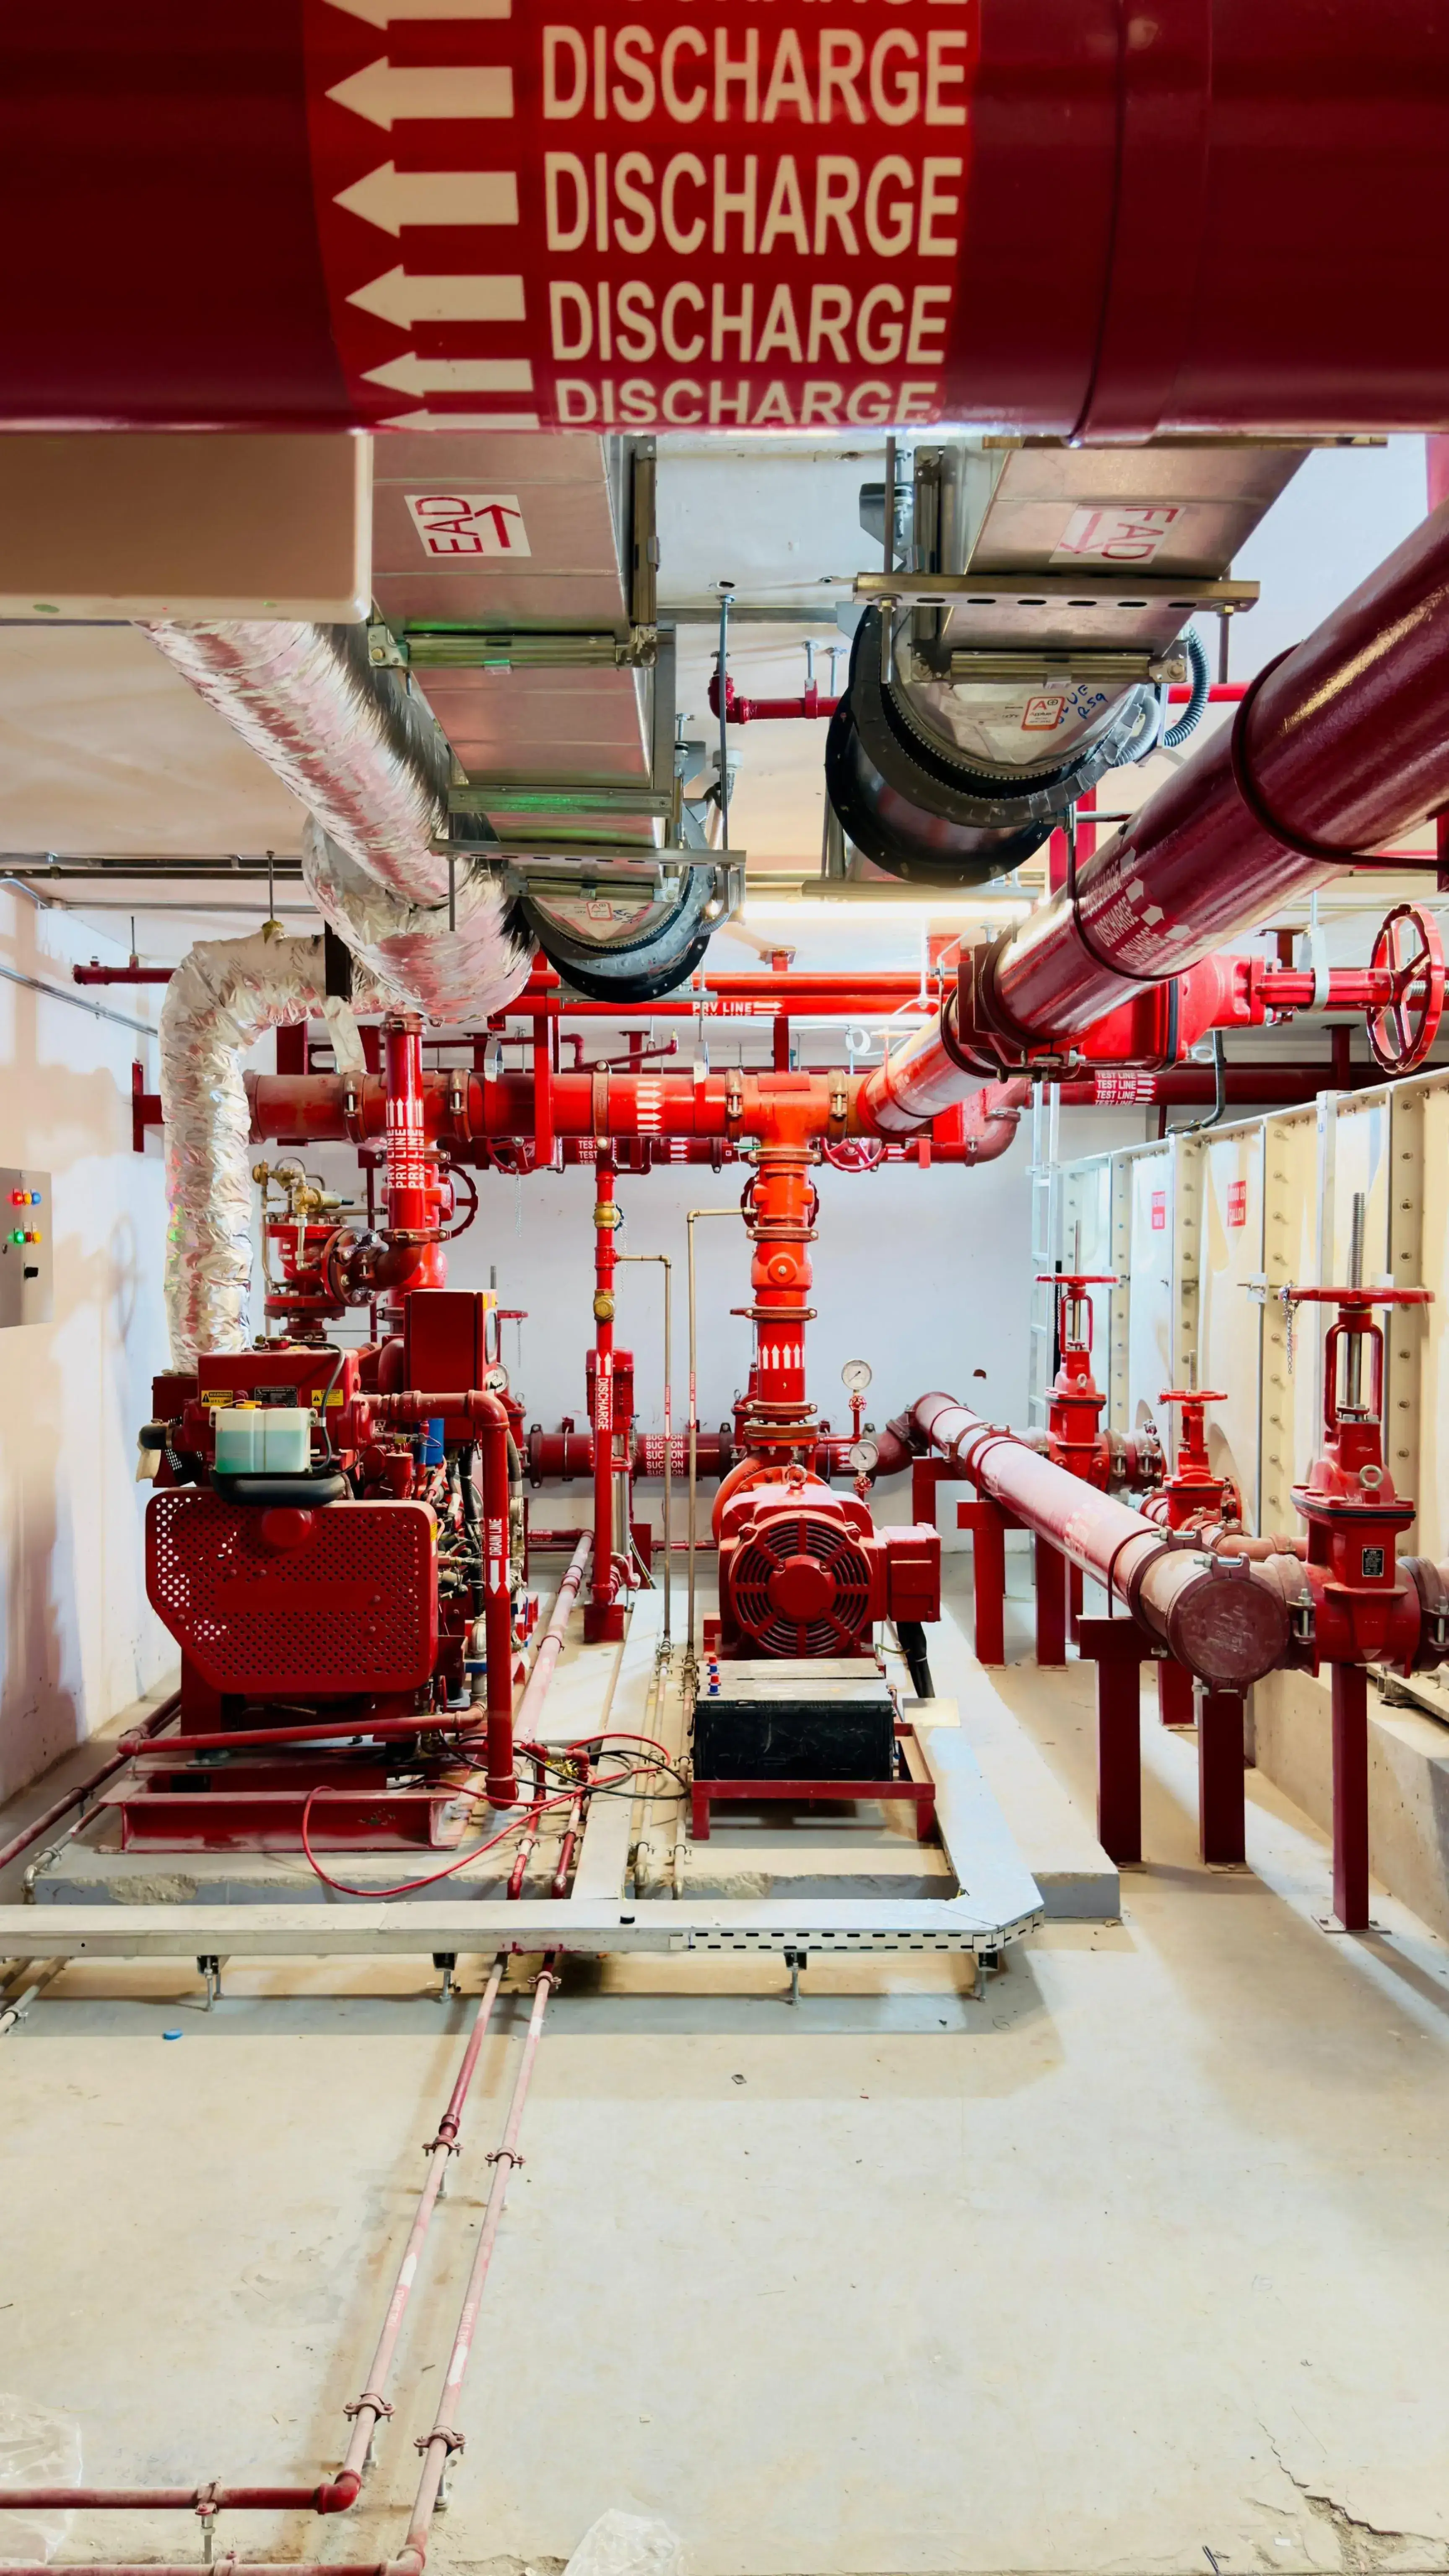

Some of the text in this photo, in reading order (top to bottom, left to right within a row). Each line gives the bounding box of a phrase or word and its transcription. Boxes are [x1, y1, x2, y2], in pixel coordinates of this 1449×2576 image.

[541, 24, 968, 126] DISCHARGE
[544, 151, 963, 257] DISCHARGE
[547, 280, 952, 364] DISCHARGE
[554, 378, 938, 425] DISCHARGE
[414, 496, 484, 553] EAD
[1093, 896, 1140, 948] DISCHARGE
[1115, 926, 1170, 967] DISCHARGE
[692, 1001, 753, 1013] PRV LINE
[1096, 1080, 1136, 1090] TEST LINE
[1096, 1090, 1136, 1100] TEST LINE
[395, 1129, 407, 1188] PRV LINE
[407, 1129, 418, 1188] PRV LINE
[598, 1377, 609, 1430] DISCHARGE
[646, 1441, 683, 1449] SUCON
[646, 1450, 683, 1459] SUCON
[646, 1460, 683, 1469] SUCON
[489, 1518, 502, 1555] DRAIN LINE
